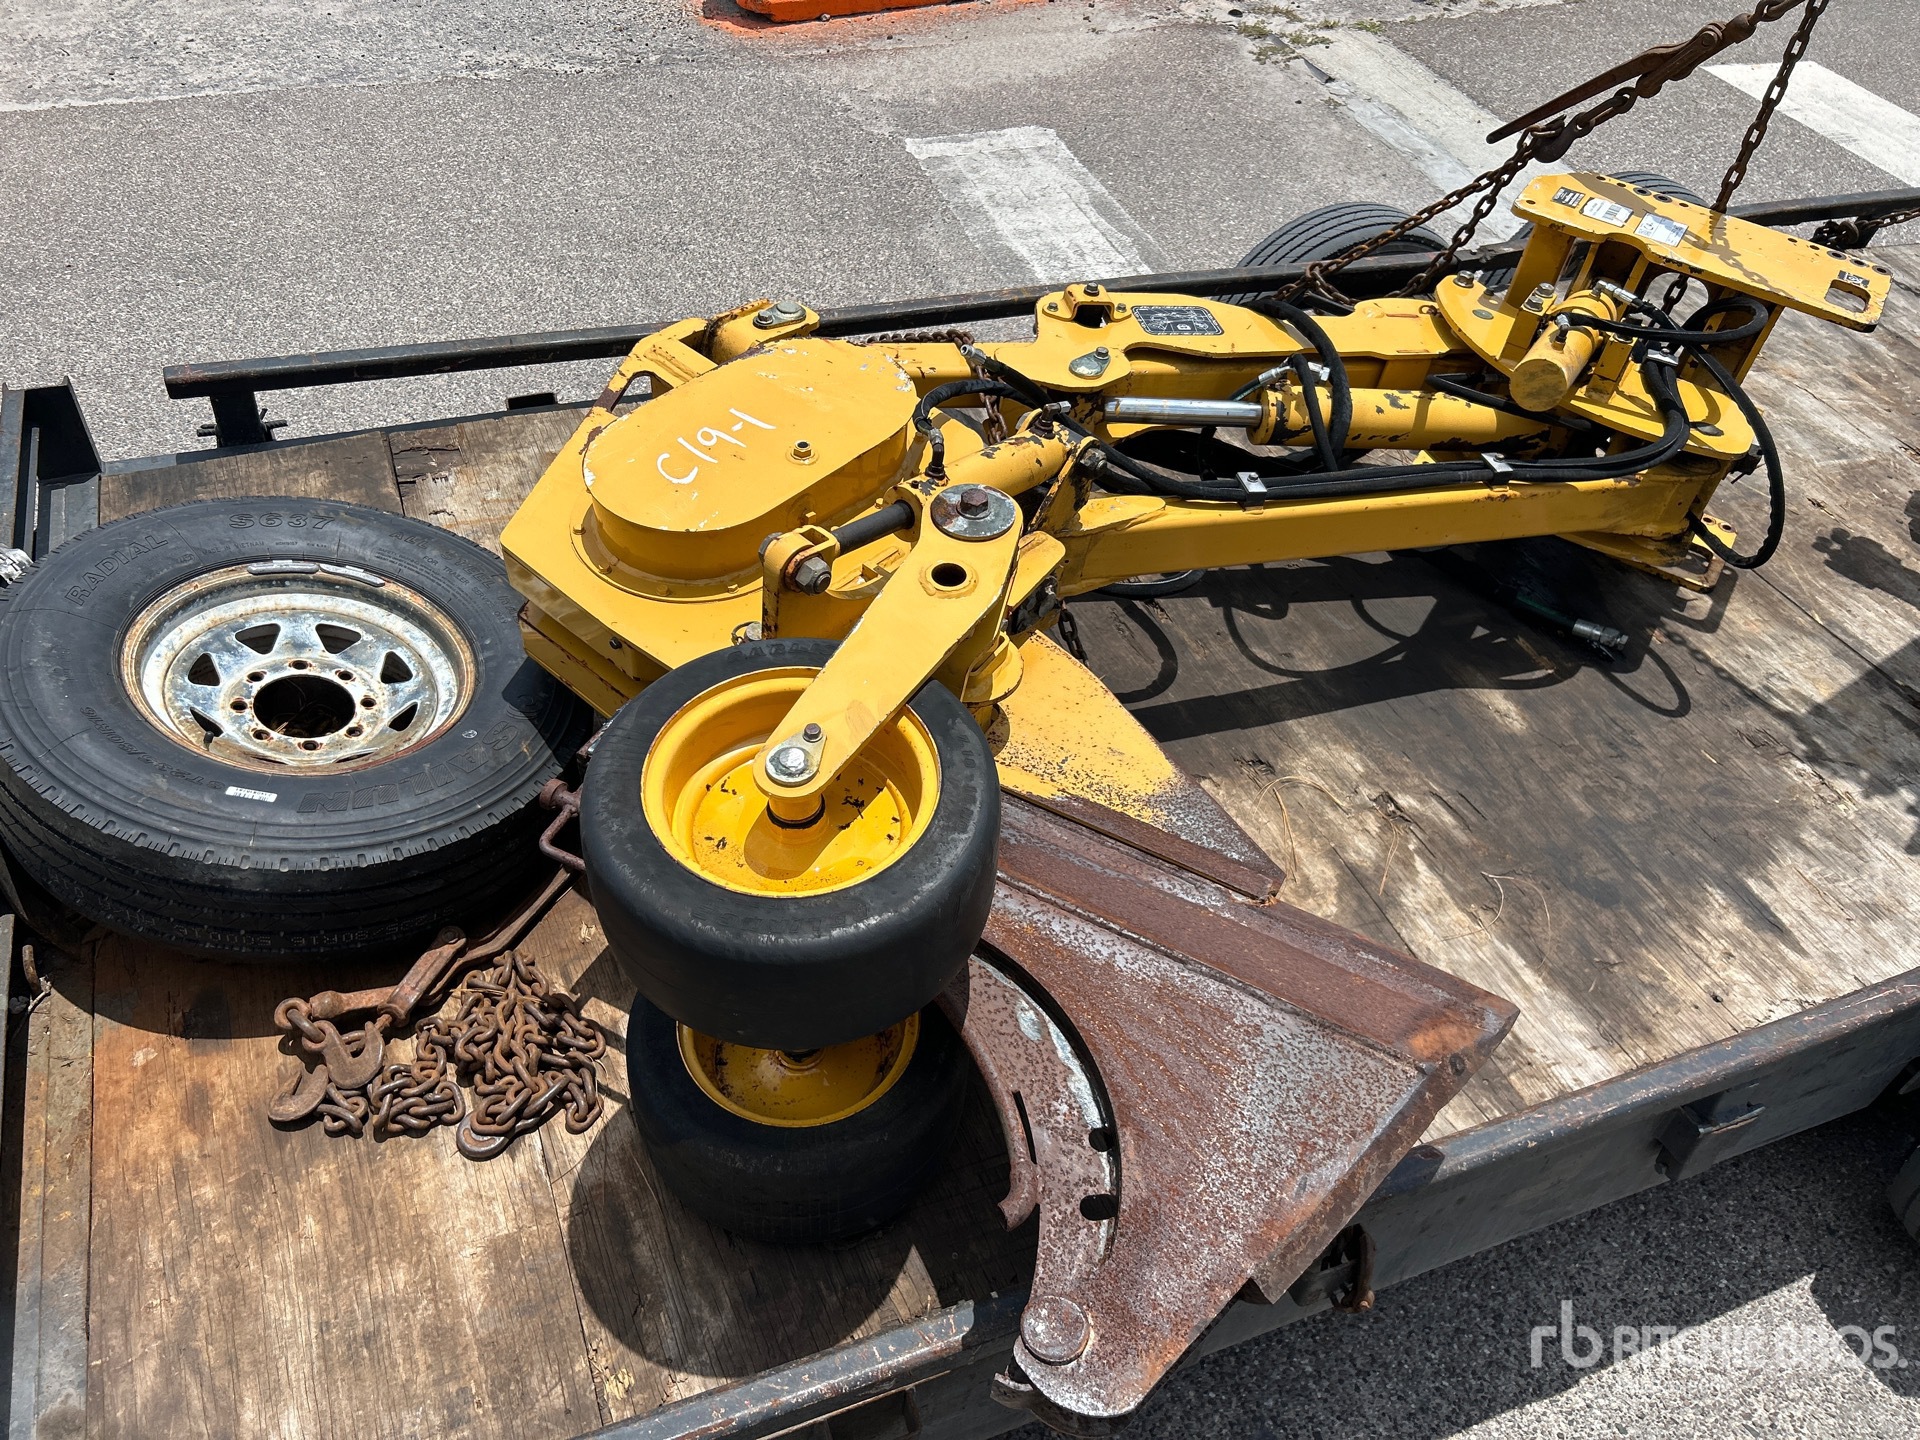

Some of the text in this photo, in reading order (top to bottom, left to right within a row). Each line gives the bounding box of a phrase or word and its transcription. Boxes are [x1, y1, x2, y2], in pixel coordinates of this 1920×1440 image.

[656, 407, 777, 485] C19-1
[228, 512, 335, 530] S637
[64, 534, 169, 606] RADIAL
[297, 720, 519, 813] SAILUN
